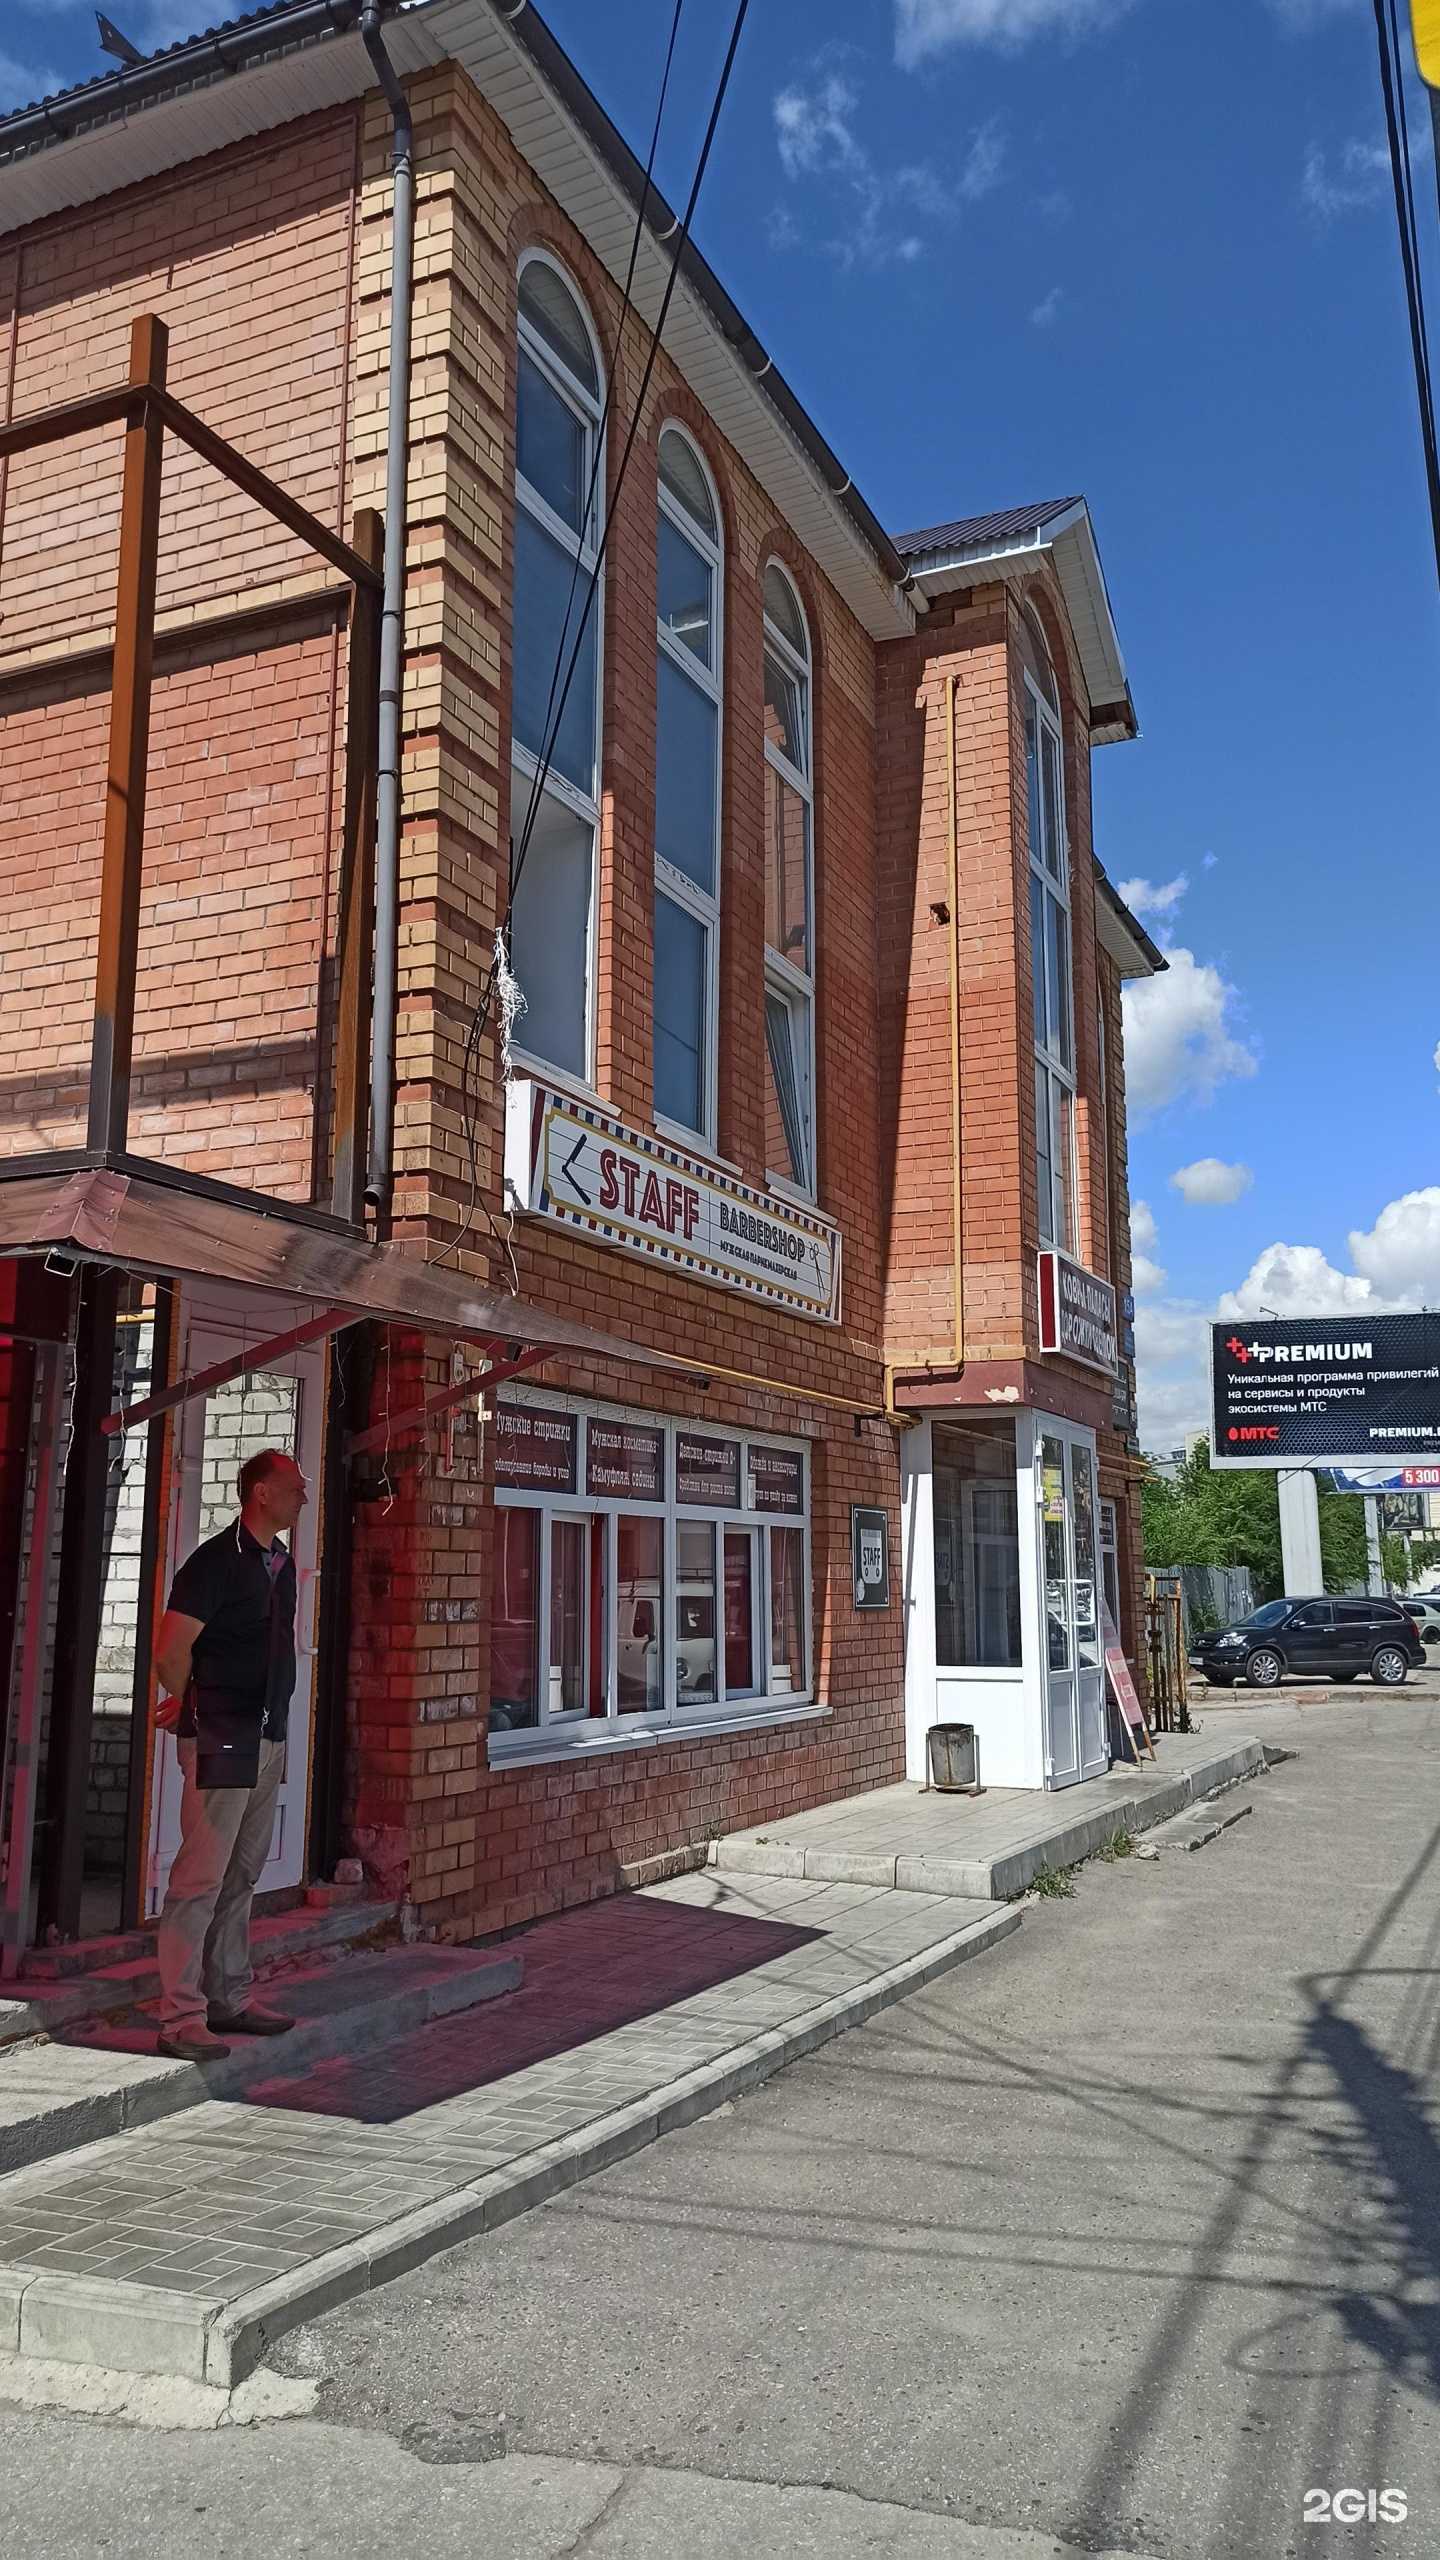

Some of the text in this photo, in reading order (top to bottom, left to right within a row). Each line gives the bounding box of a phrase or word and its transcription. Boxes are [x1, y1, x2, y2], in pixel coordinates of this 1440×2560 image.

[600, 1149, 700, 1241] STAFF
[720, 1202, 806, 1263] BARBERSHOP
[720, 1240, 798, 1280] МУЖСКАЯ ПАРИКМАХЕРСКАЯ
[1257, 1342, 1373, 1363] PREMIUM
[1227, 1366, 1440, 1385] Уникальная программа привилегий
[1227, 1387, 1366, 1401] на сервисы и продукты
[1227, 1401, 1328, 1414] экосистемы МТС
[533, 1420, 571, 1442] стрижки
[591, 1429, 622, 1449] Мужская
[1240, 1426, 1280, 1440] МТС
[592, 1464, 656, 1489] Камуфляж седины
[1415, 1469, 1440, 1483] 300
[863, 1546, 881, 1566] STAFF
